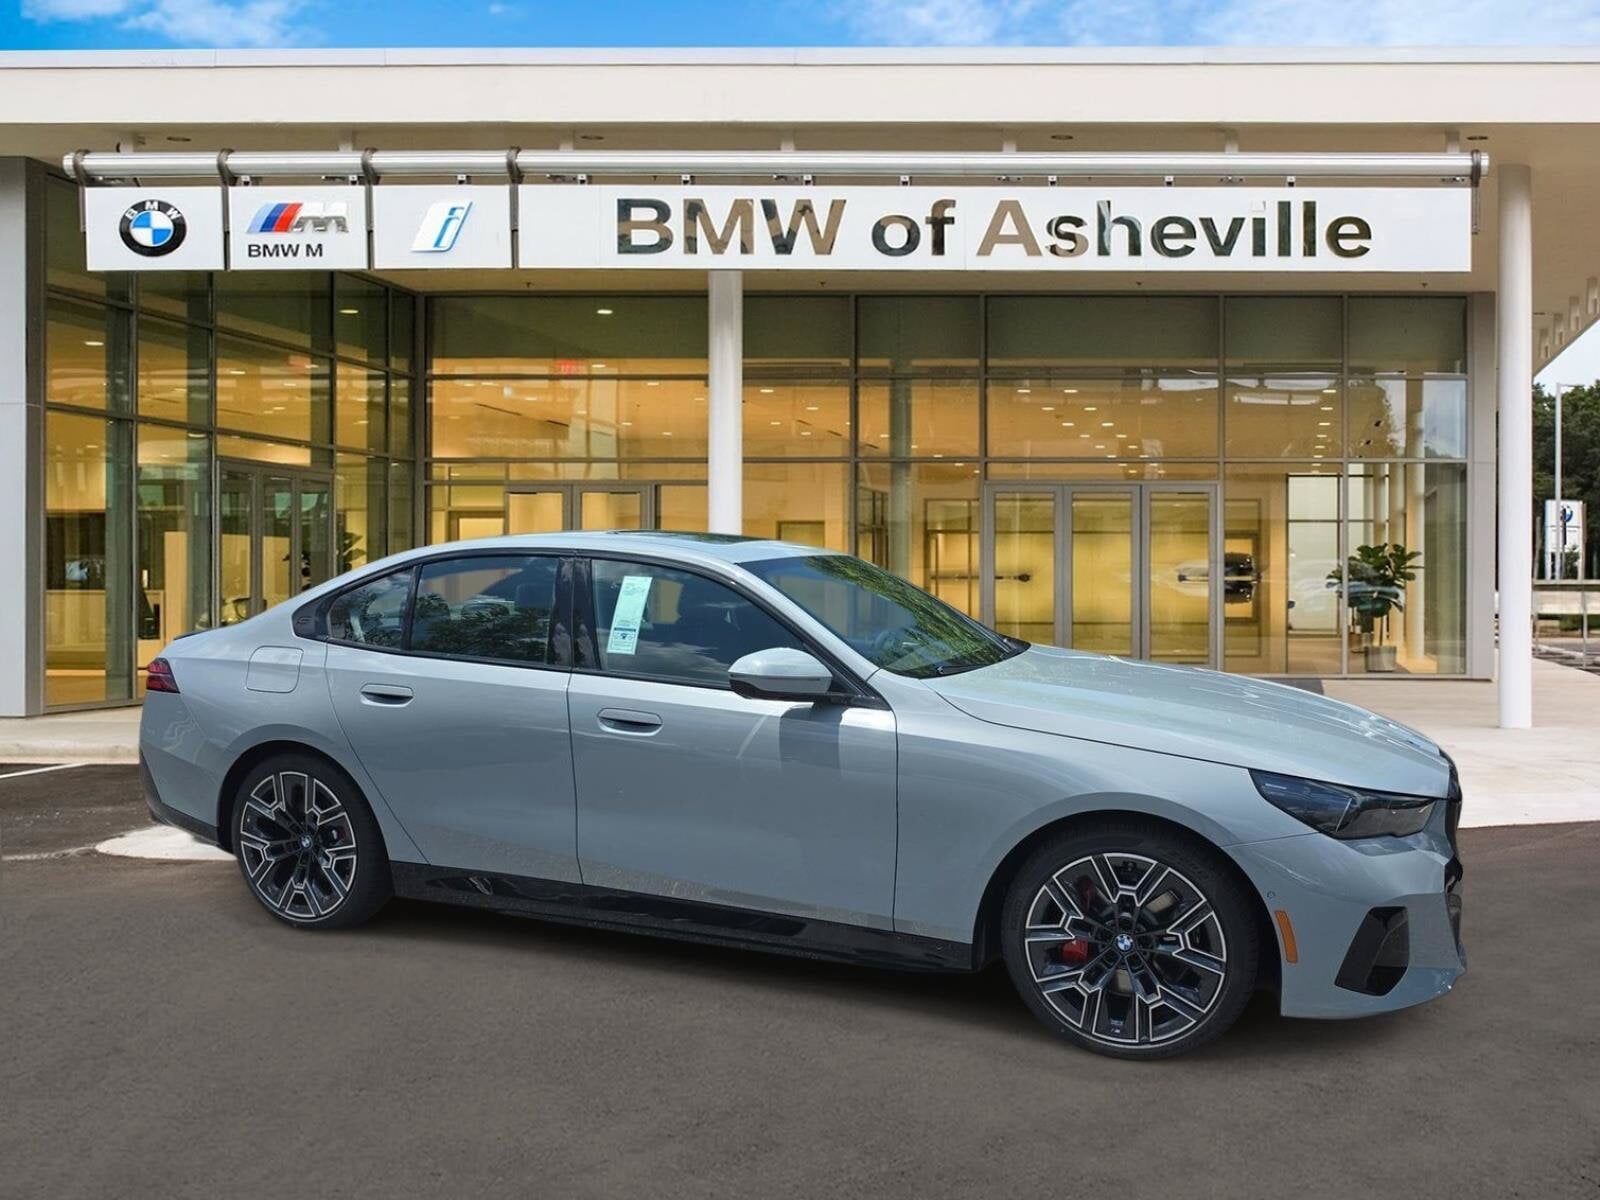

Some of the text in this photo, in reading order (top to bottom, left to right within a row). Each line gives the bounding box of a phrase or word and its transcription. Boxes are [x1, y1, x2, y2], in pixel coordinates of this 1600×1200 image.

[125, 200, 182, 220] BMW
[616, 198, 1373, 258] BMW of Asheville
[247, 243, 323, 258] BMW M
